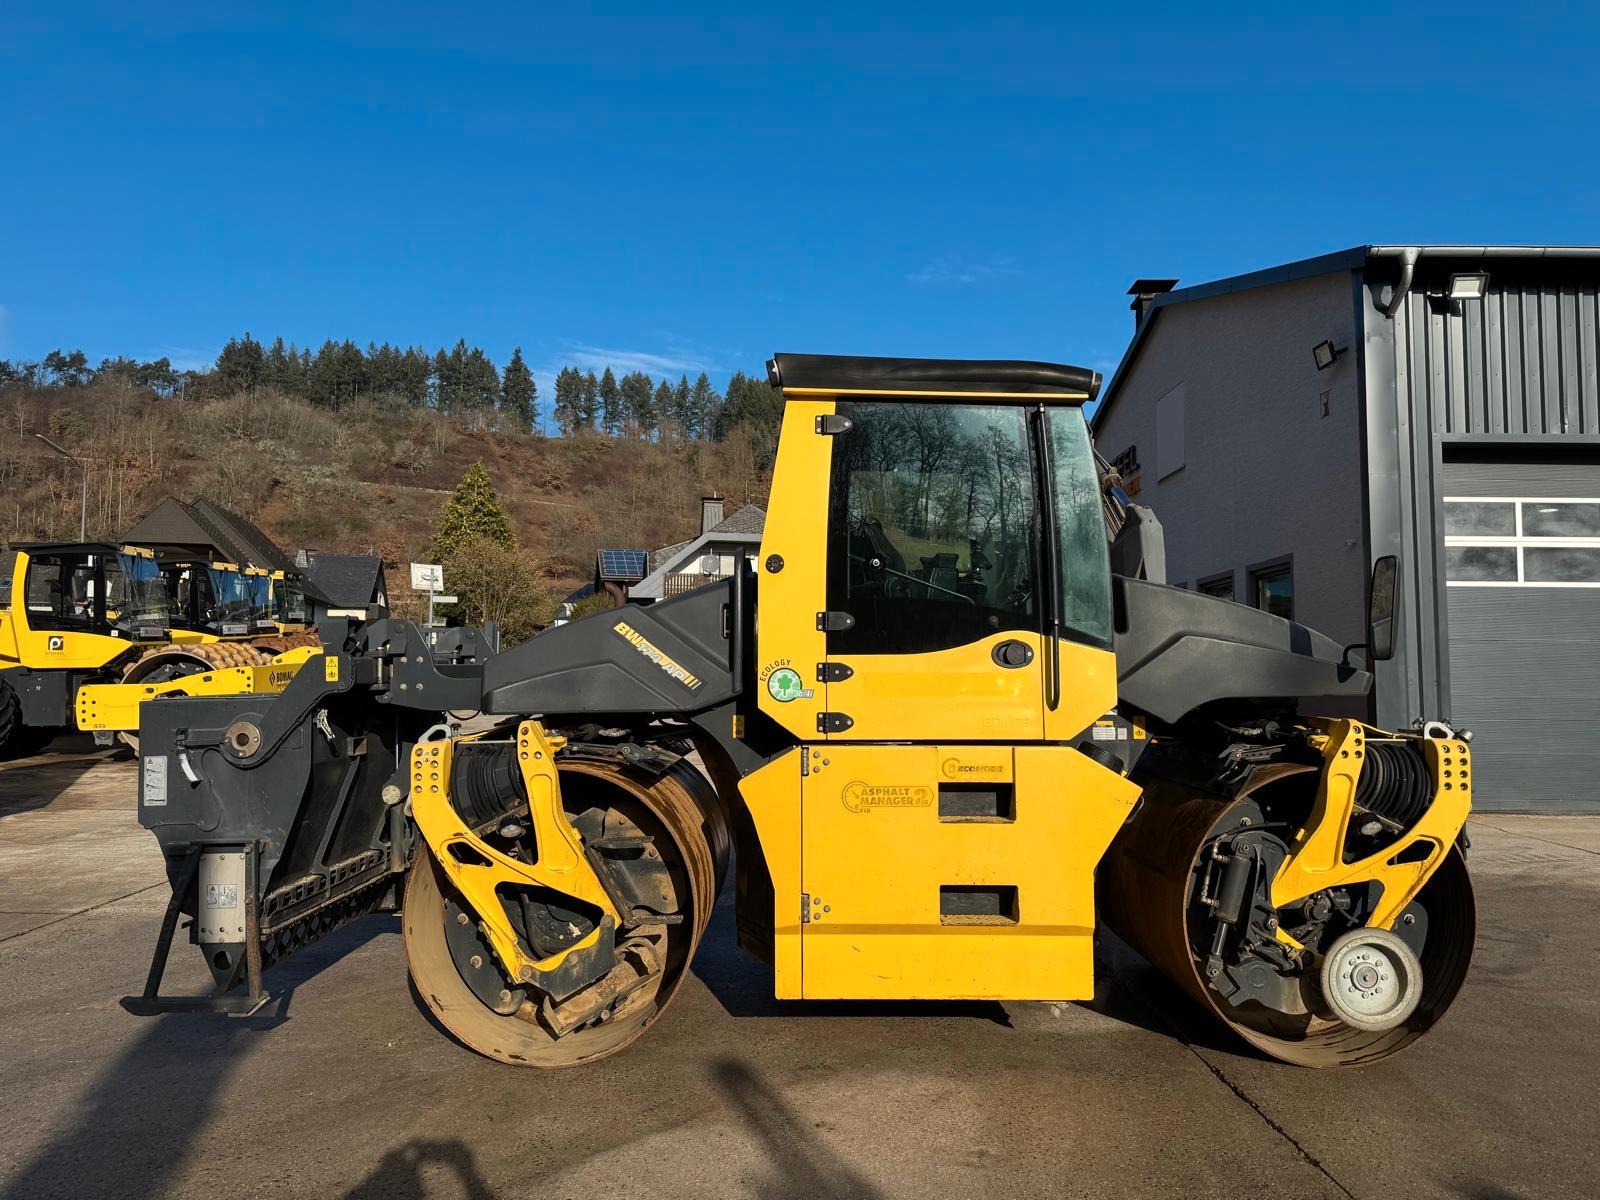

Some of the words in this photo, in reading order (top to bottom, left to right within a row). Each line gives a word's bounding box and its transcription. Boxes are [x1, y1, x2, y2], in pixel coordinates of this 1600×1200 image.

[613, 622, 645, 648] BW
[636, 642, 663, 664] 174
[661, 662, 687, 681] AP
[760, 658, 791, 682] ECOLOGY
[860, 797, 914, 805] MANAGER
[861, 788, 910, 796] ASPHALT
[914, 788, 929, 805] 2
